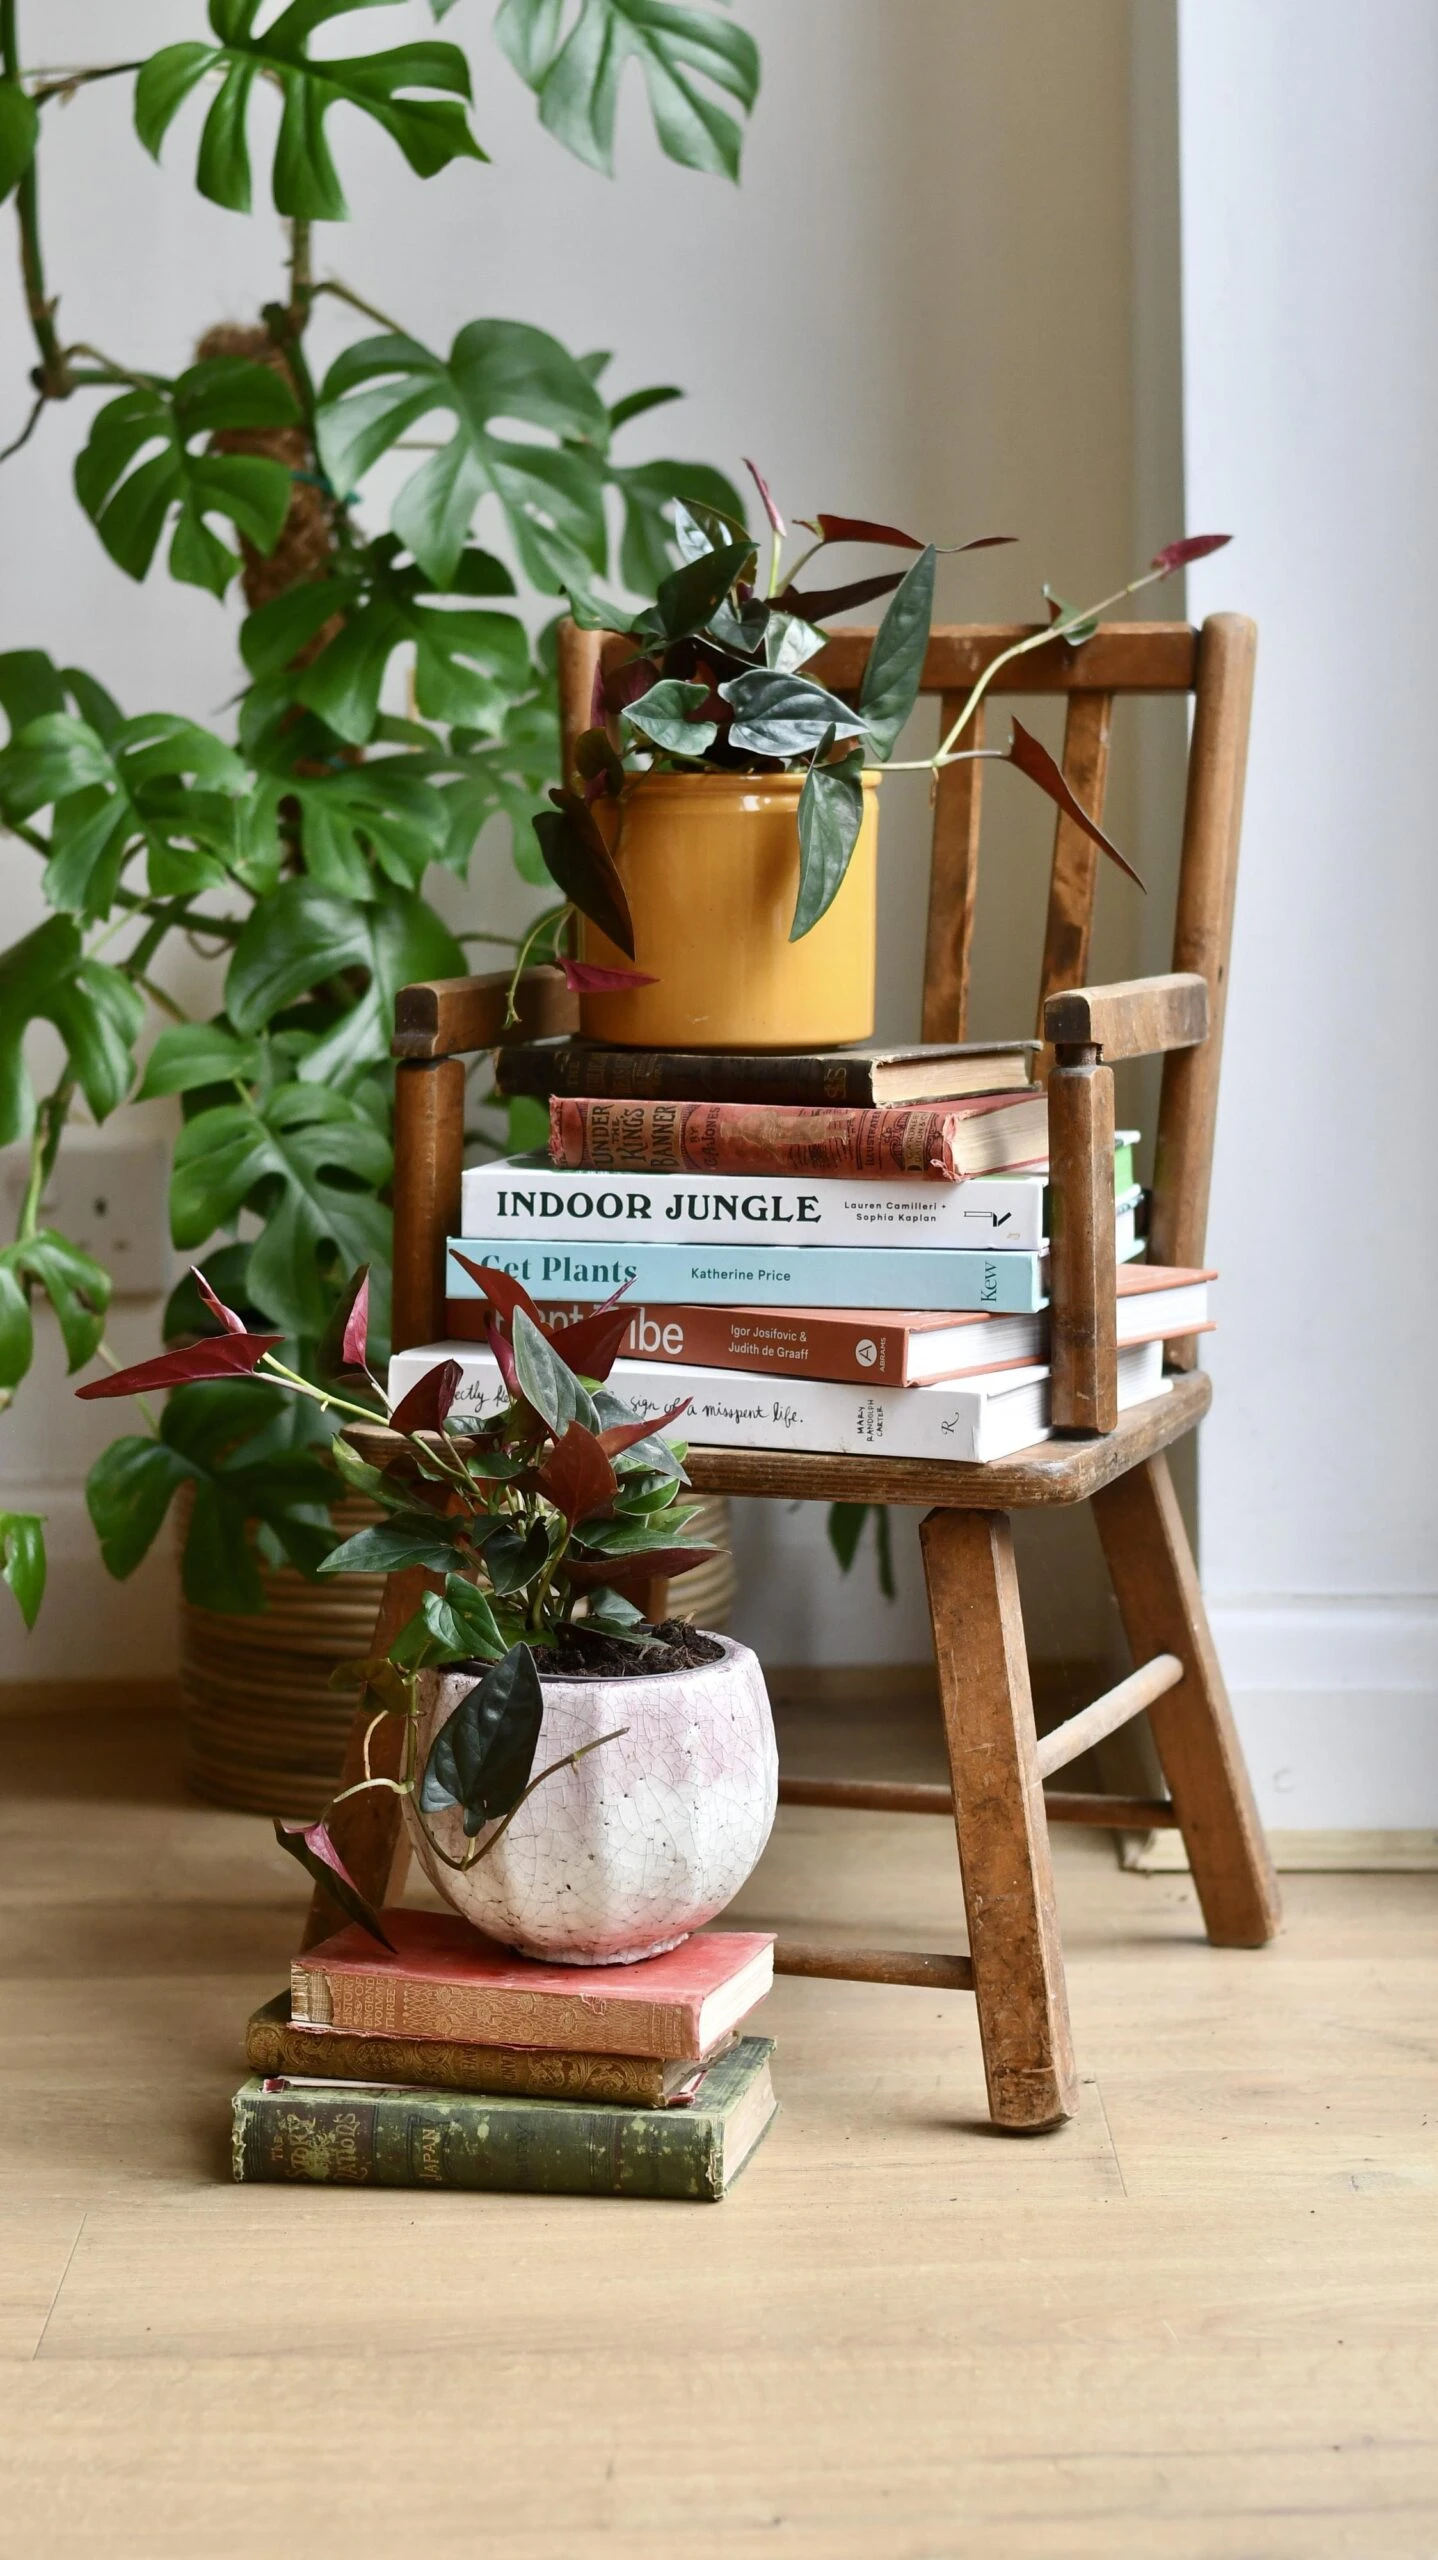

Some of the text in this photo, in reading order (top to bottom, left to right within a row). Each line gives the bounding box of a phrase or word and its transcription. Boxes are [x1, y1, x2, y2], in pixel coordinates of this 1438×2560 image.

[591, 1103, 615, 1166] UNDER
[612, 1116, 621, 1145] THE
[616, 1107, 649, 1162] KING'S
[651, 1103, 681, 1168] BANNER
[690, 1125, 699, 1144] BY
[865, 1111, 882, 1166] ILLUSTRATED
[497, 1191, 822, 1223] INDOOR JUNGLE
[844, 1201, 882, 1209] Lauren
[886, 1202, 937, 1211] Camilleri
[856, 1213, 937, 1223] Sophia Kaplan
[542, 1256, 638, 1283] Plants
[691, 1267, 791, 1281] Katherine Price
[980, 1261, 998, 1302] Kew
[731, 1324, 807, 1342] Igor Josifovic &
[728, 1342, 809, 1360] Judith de Graaff
[879, 1337, 887, 1373] ABRAMS
[630, 1396, 660, 1417] sign
[687, 1405, 697, 1415] a
[702, 1402, 769, 1425] misspent
[772, 1401, 804, 1428] life.
[857, 1406, 865, 1434] MARY
[343, 1976, 354, 2026] HISTORY
[354, 1976, 365, 1997] OF
[363, 1977, 375, 2030] ENGLAND
[385, 1989, 396, 2031] THREE
[284, 2113, 316, 2178] STORY
[419, 2128, 442, 2181] JAPAN
